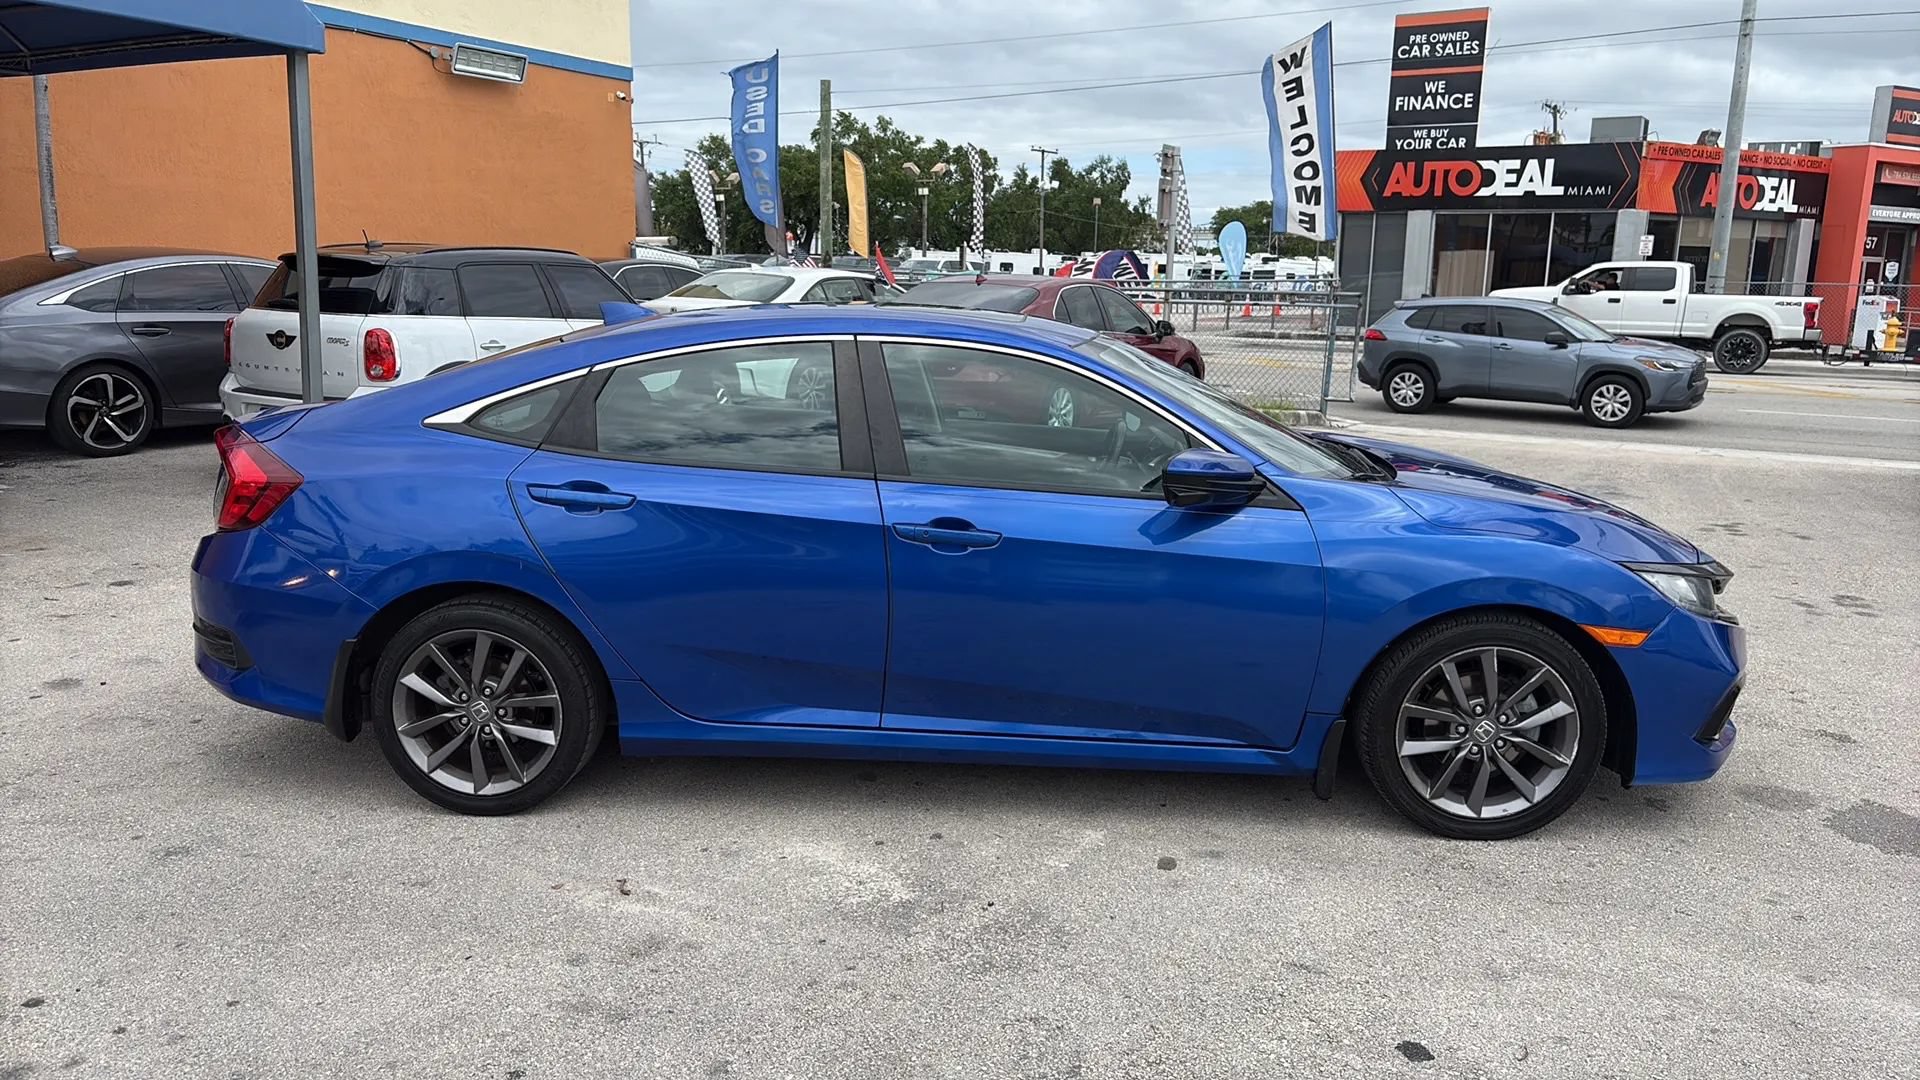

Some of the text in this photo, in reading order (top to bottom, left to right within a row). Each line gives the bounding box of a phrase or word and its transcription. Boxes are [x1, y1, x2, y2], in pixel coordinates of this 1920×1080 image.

[1409, 31, 1470, 44] PRE OWNED
[1397, 40, 1480, 59] CAR SALES
[1424, 80, 1446, 94] WE
[1395, 93, 1474, 111] FINANCE
[1413, 128, 1450, 138] WE BUY
[1395, 137, 1467, 150] YOUR CAR
[1692, 148, 1704, 159] CAR
[1705, 150, 1721, 160] SALES
[1764, 156, 1773, 165] NO
[1567, 184, 1612, 196] MIAMI
[1799, 205, 1820, 215] MIAMI
[1865, 236, 1878, 250] 57
